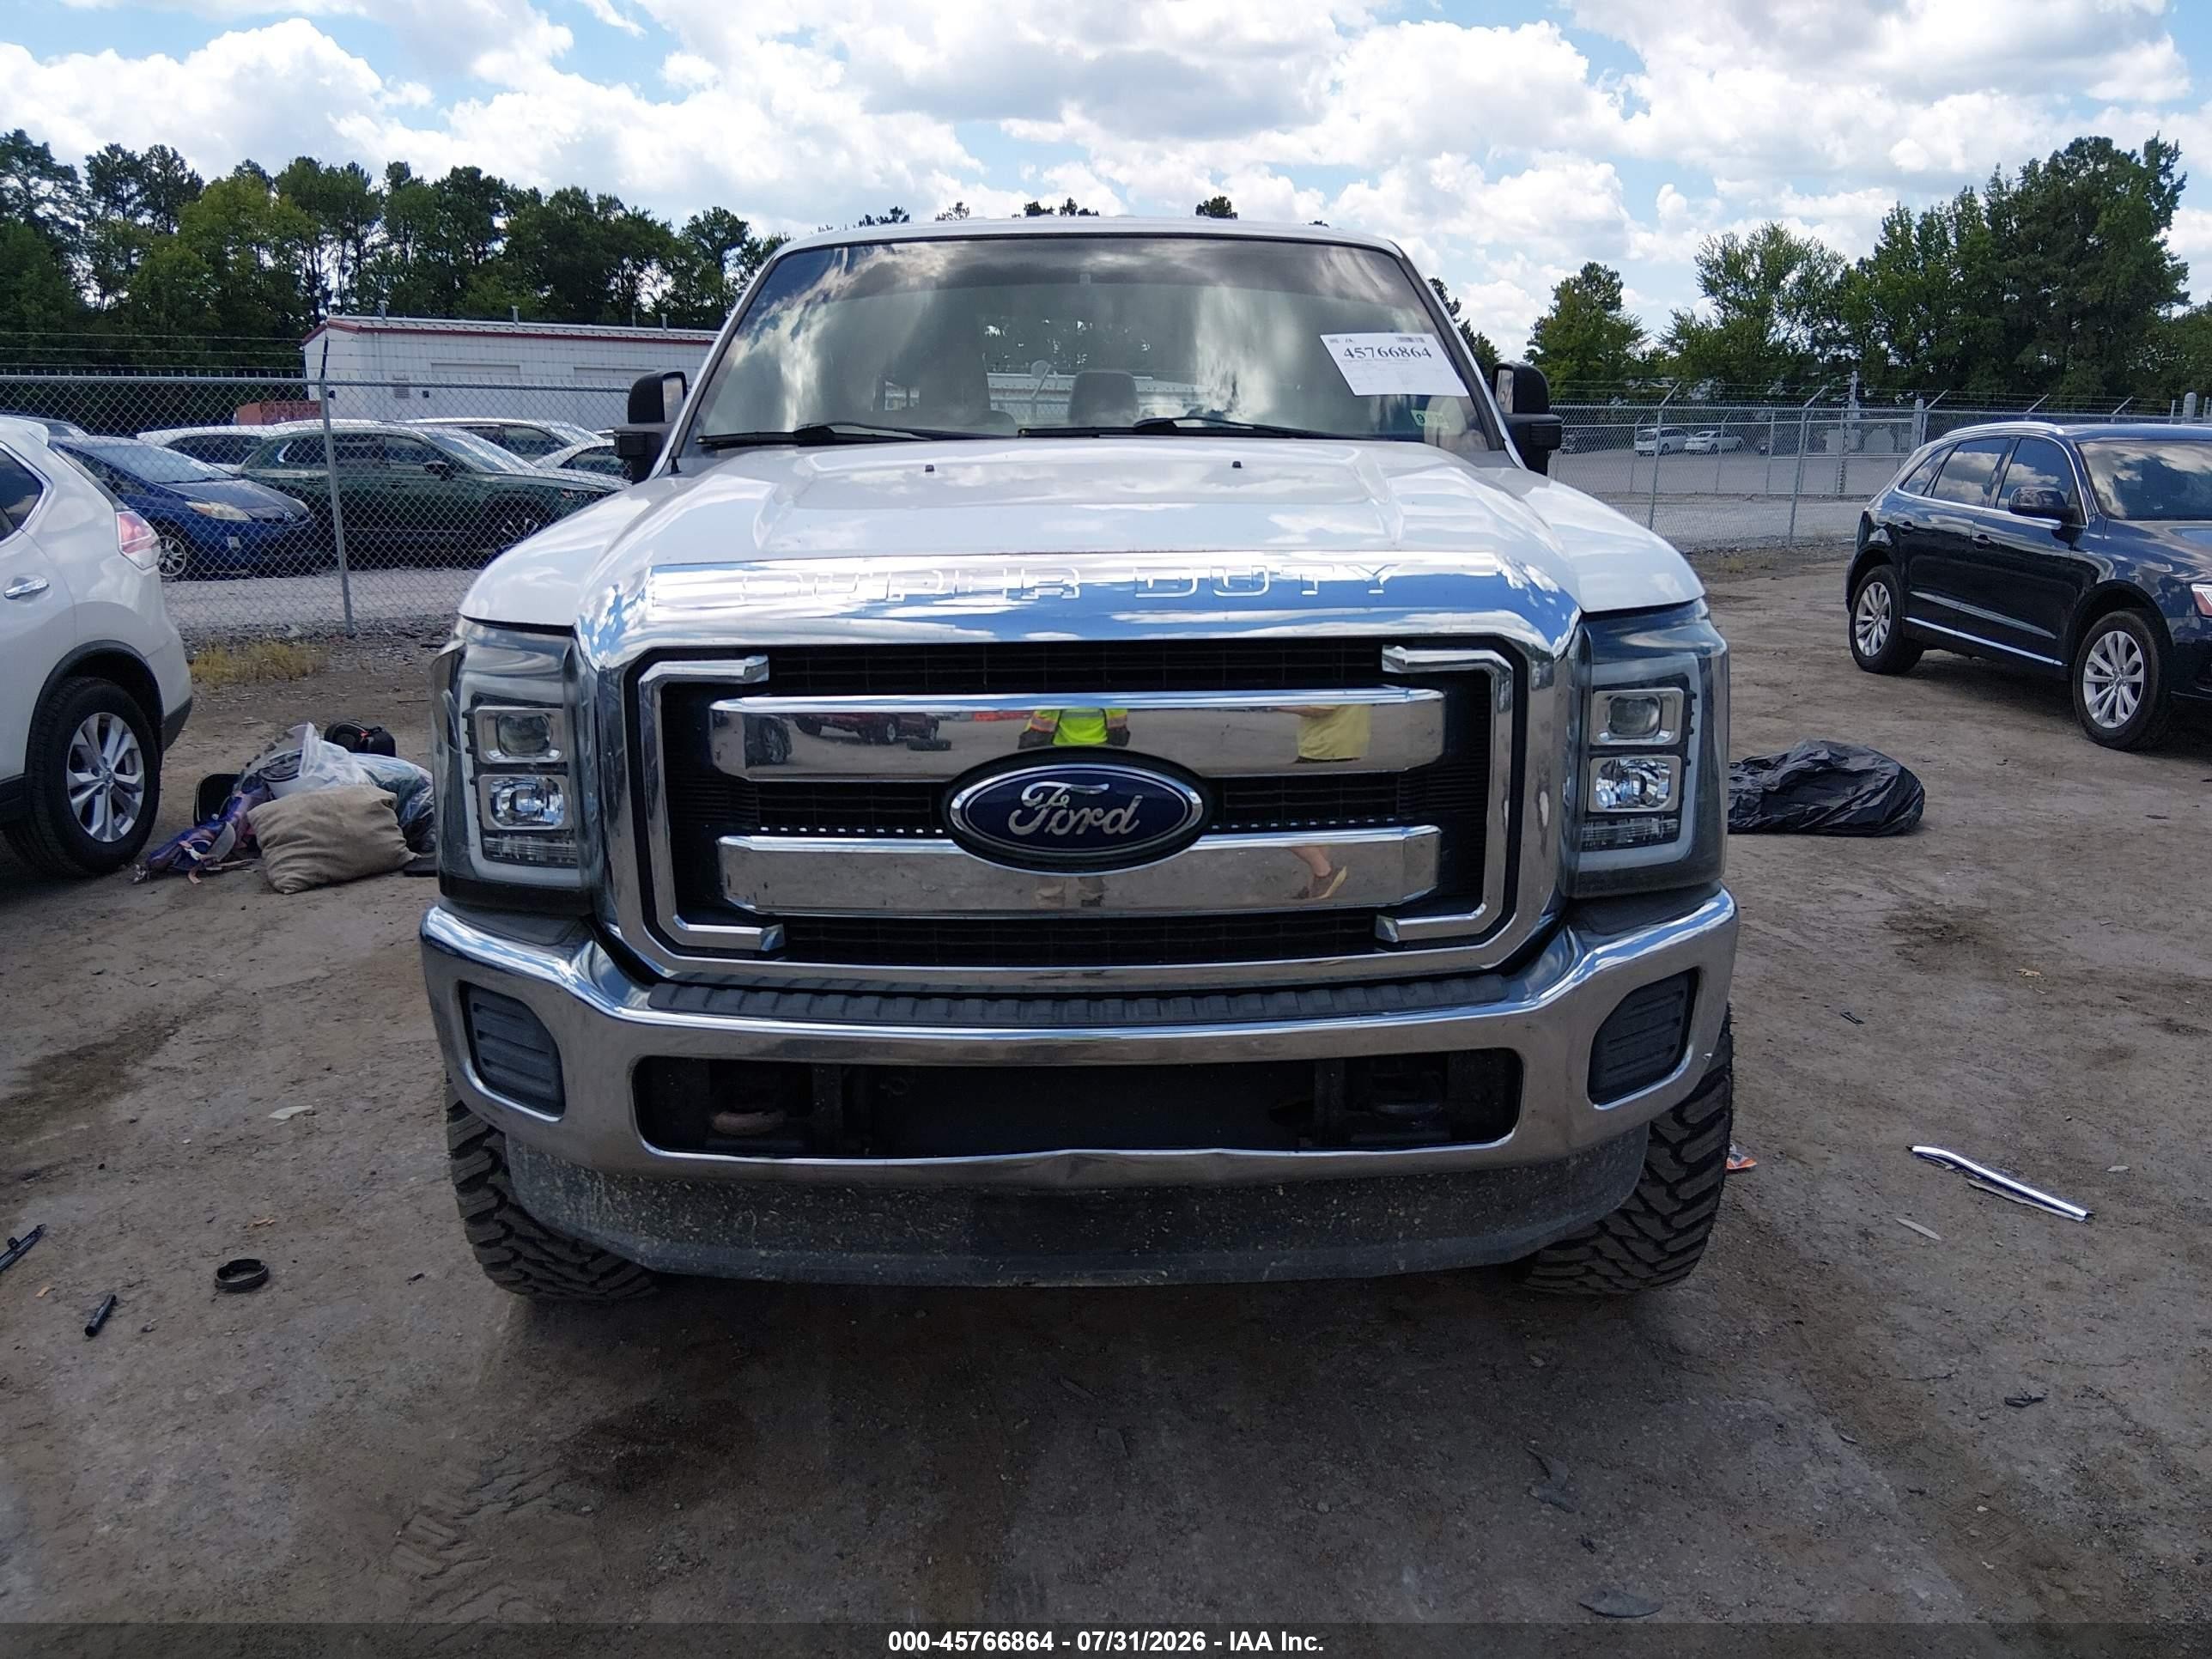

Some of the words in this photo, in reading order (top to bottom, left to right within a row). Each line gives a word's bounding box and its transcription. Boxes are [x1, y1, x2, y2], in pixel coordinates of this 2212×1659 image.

[1344, 346, 1432, 359] 45766864
[1133, 563, 1401, 599] DUTY
[1008, 781, 1143, 836] Ford
